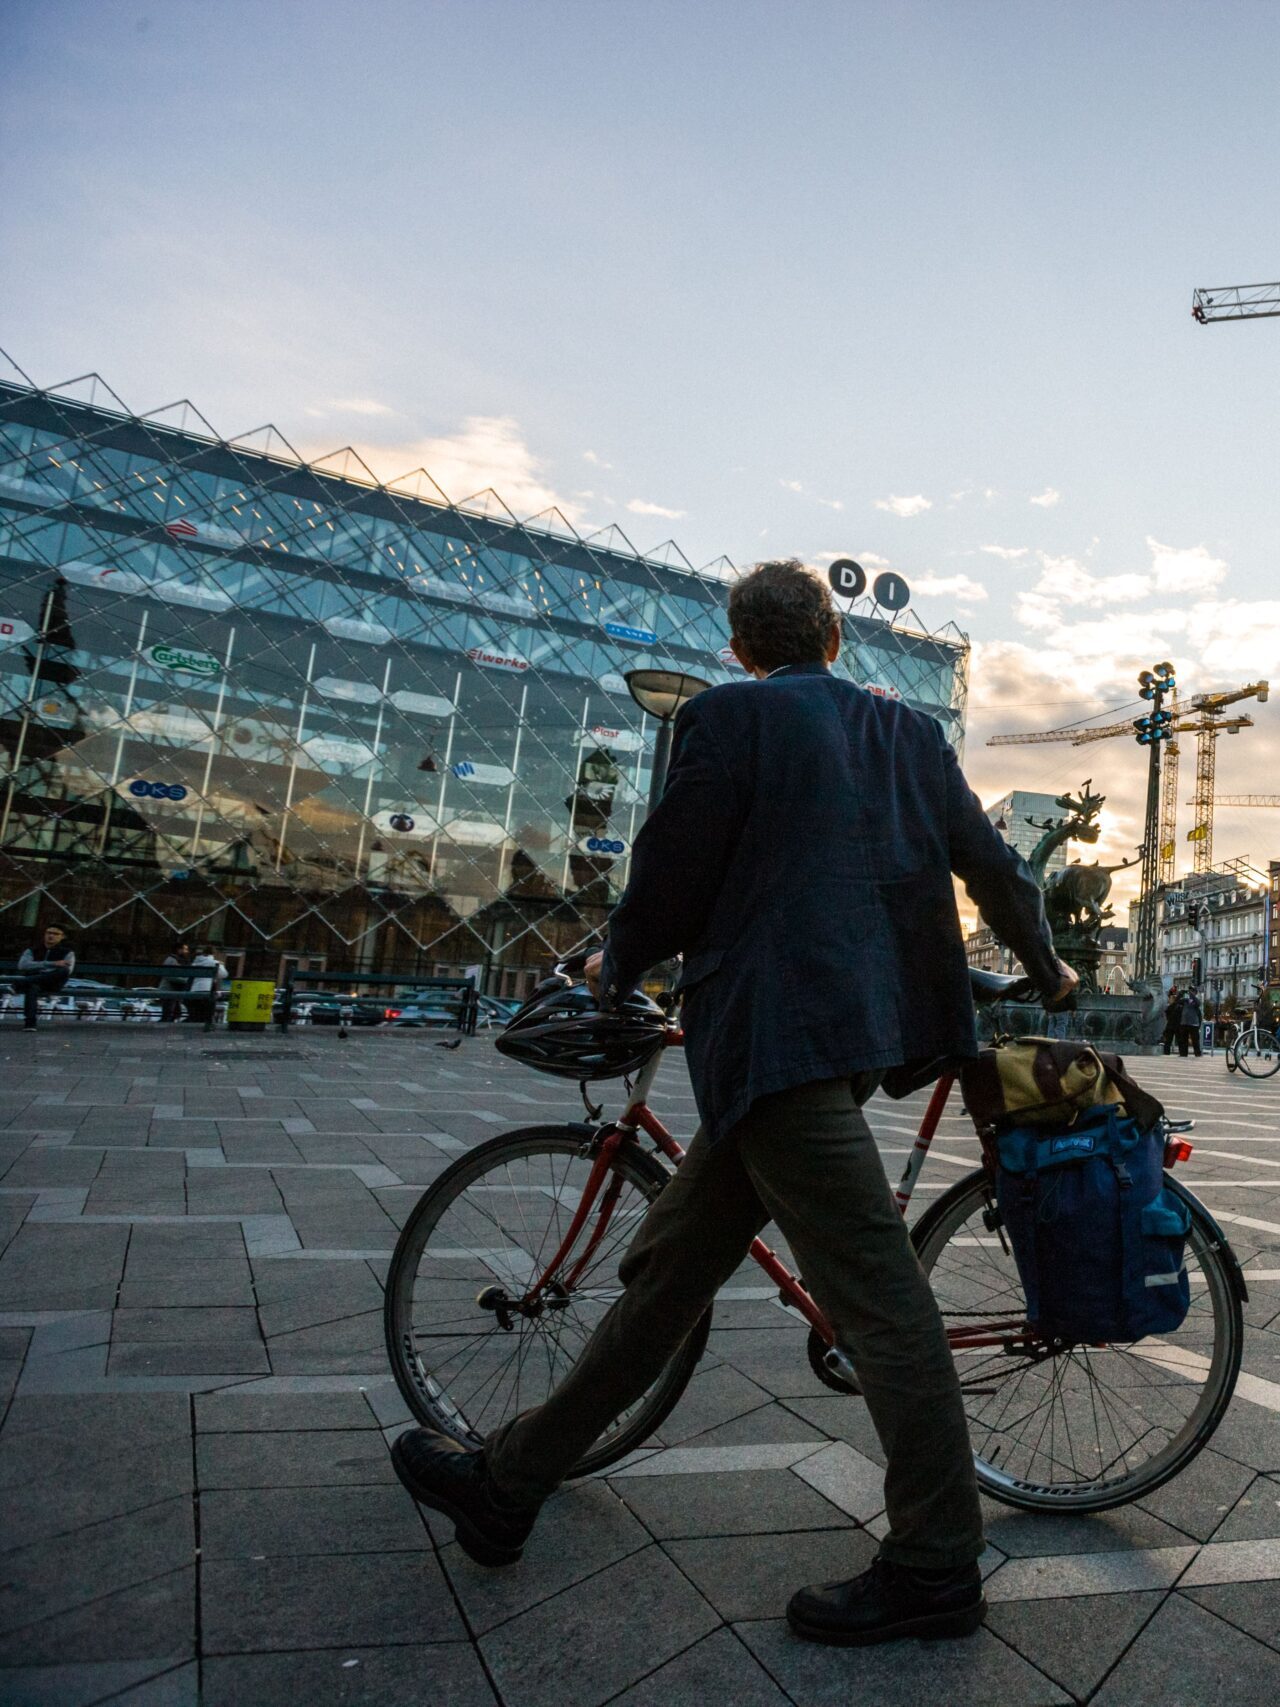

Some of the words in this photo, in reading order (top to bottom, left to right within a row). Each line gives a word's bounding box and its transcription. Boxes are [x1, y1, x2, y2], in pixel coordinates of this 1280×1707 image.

[840, 567, 857, 588] D
[152, 645, 220, 675] Carlsberg
[468, 649, 528, 670] Elworks
[1205, 1025, 1211, 1039] P
